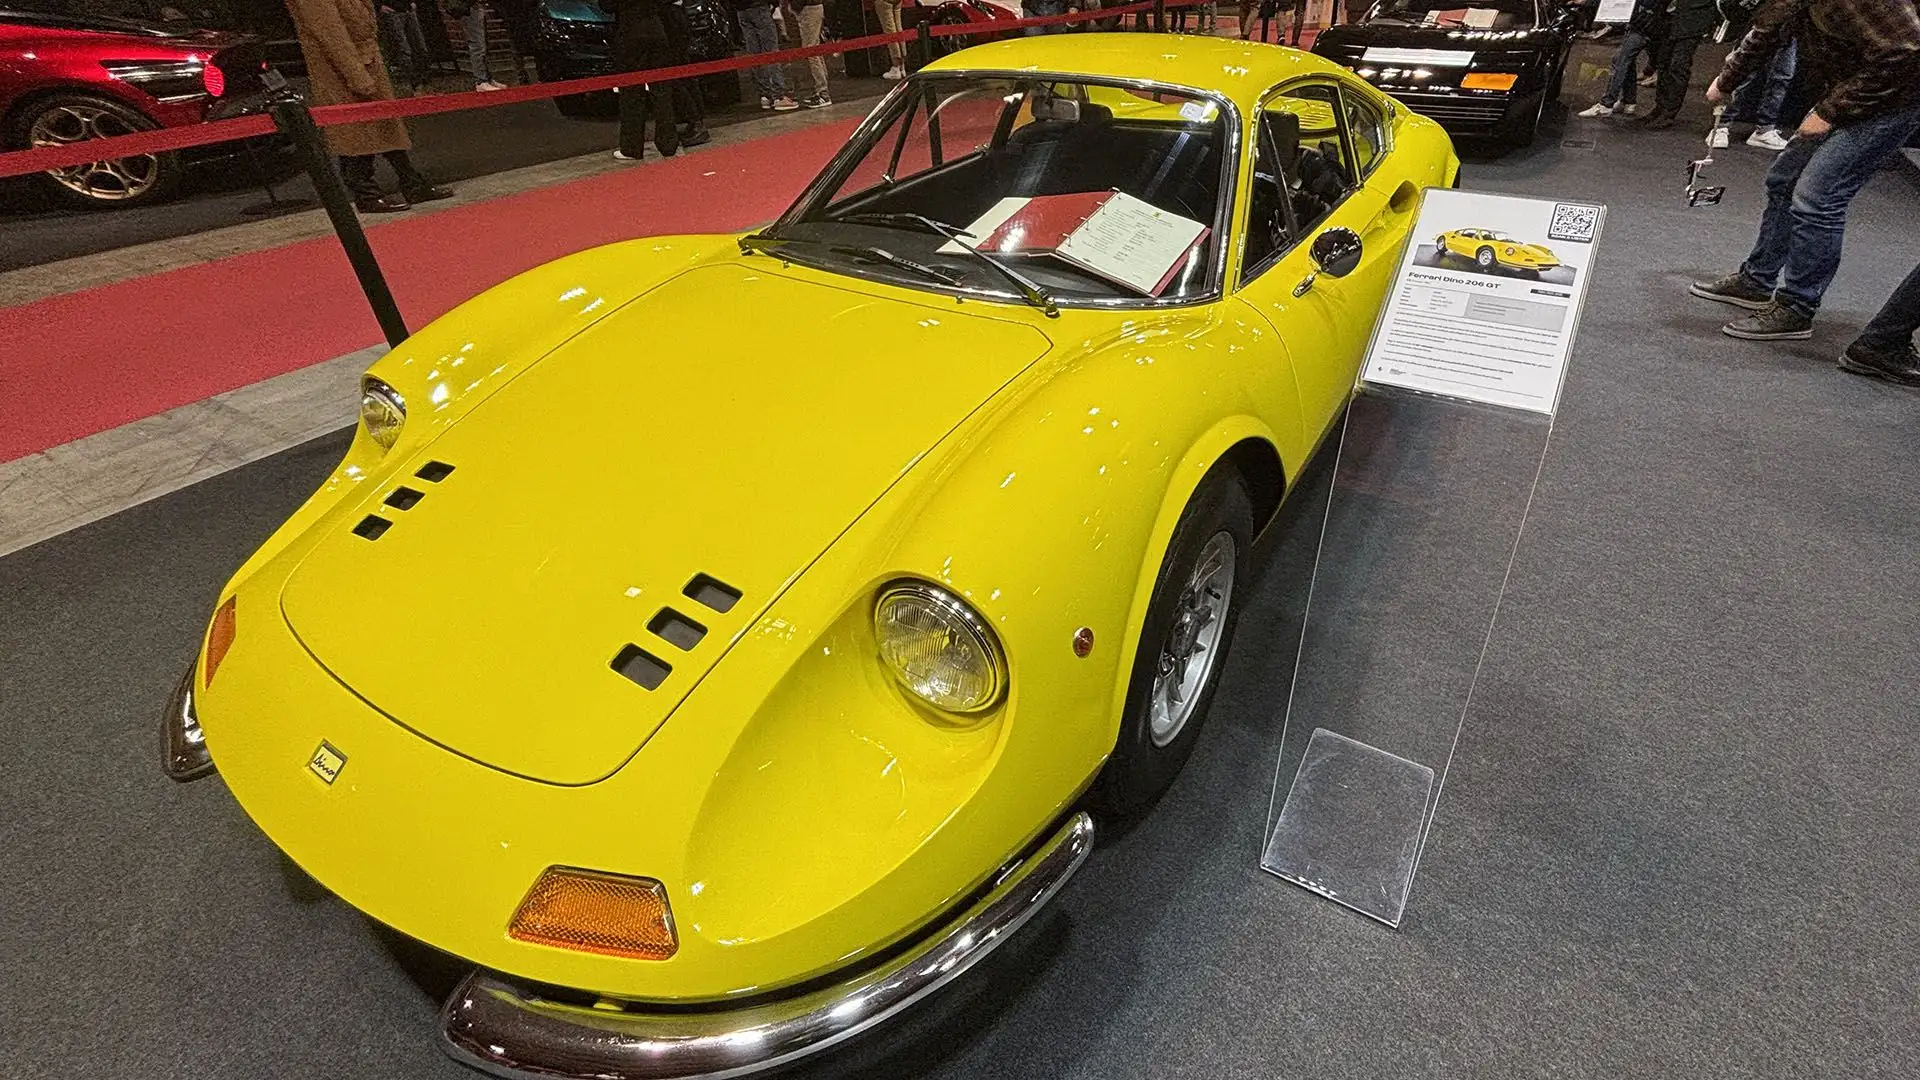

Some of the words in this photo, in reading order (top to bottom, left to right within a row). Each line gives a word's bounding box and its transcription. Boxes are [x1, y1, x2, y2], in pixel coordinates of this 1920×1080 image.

[1408, 271, 1442, 281] Ferrari
[1443, 275, 1465, 284] Dino
[1465, 279, 1485, 287] 206
[312, 753, 335, 775] Dino
